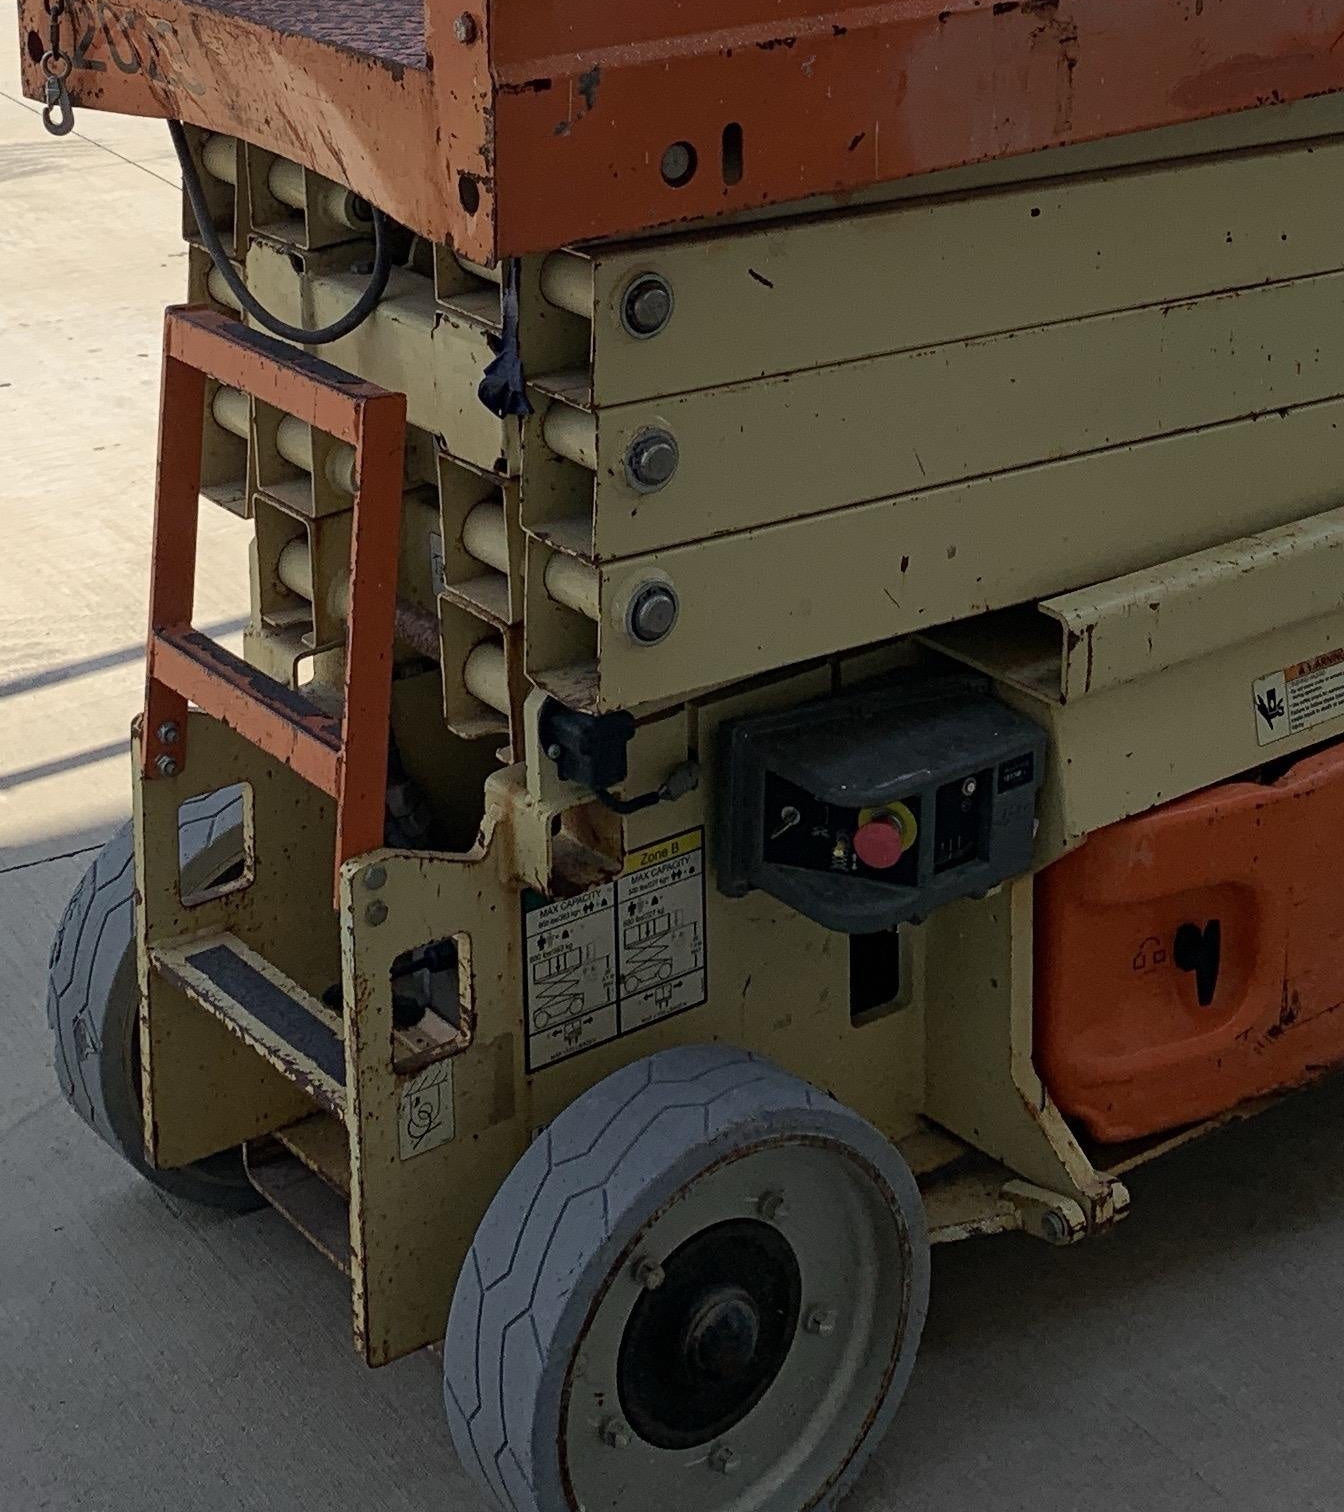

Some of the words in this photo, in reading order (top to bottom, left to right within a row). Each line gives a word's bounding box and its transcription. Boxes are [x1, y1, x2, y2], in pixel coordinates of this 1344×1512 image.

[640, 851, 669, 866] Zone
[671, 841, 680, 854] B
[630, 870, 651, 885] MAX
[652, 855, 692, 877] CAPACITY
[539, 905, 560, 919] MAX
[561, 889, 602, 910] CAPACITY
